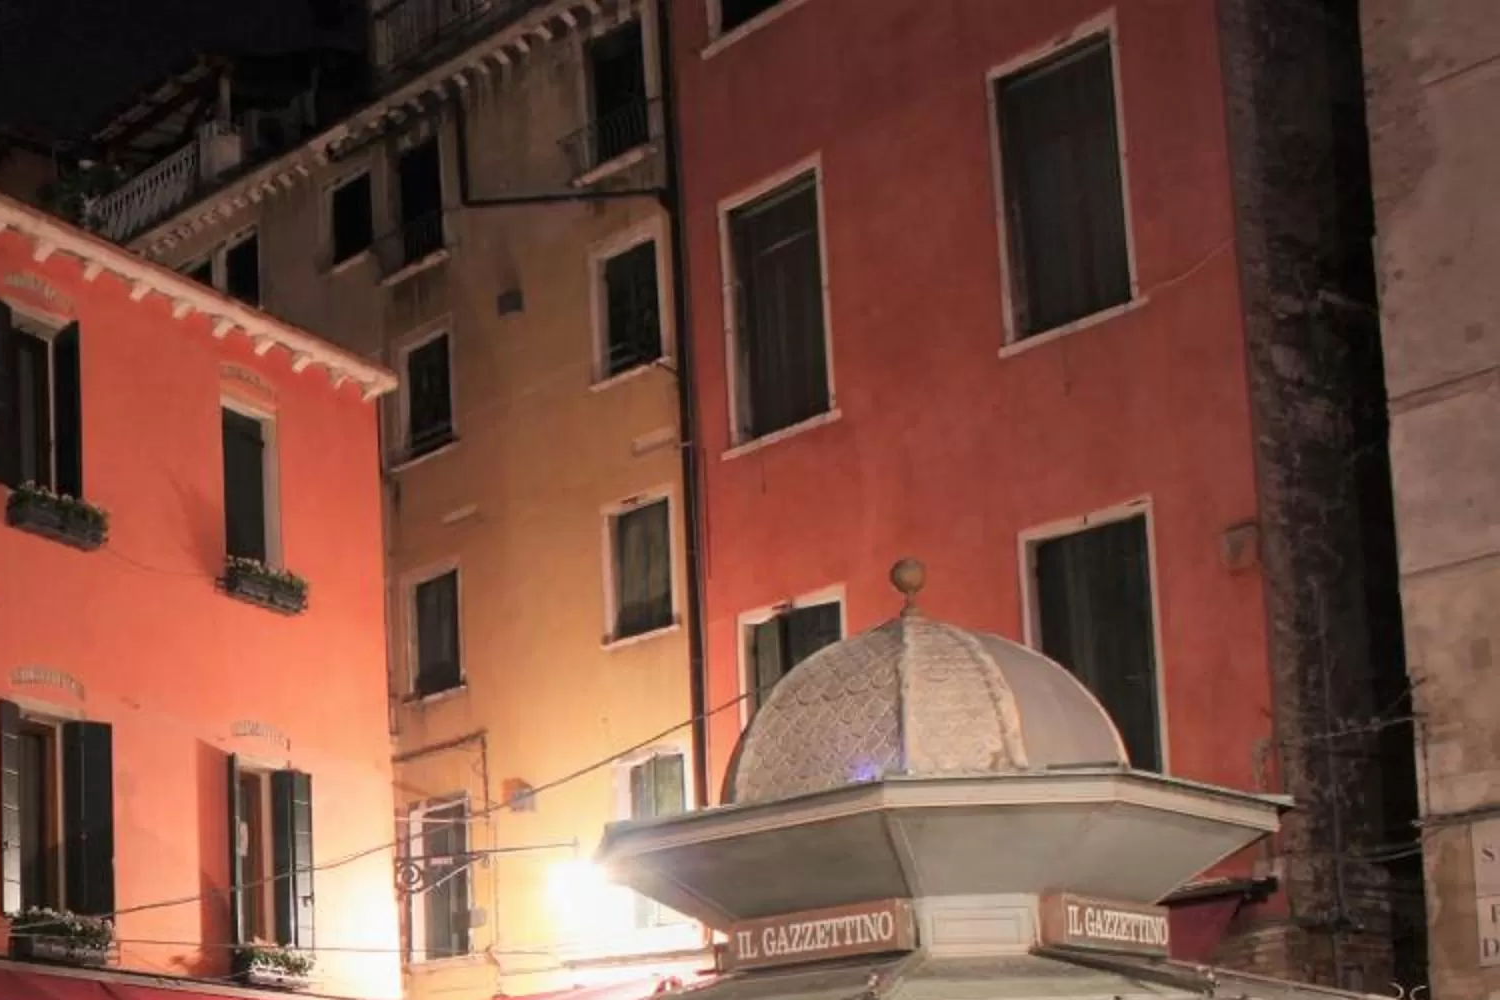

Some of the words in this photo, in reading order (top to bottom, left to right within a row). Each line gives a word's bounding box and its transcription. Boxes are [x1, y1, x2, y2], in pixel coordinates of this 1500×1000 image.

[737, 931, 758, 959] IL
[763, 911, 894, 955] GAZZETTINO
[1068, 905, 1083, 935] IL
[1085, 907, 1169, 946] GAZZETTINO
